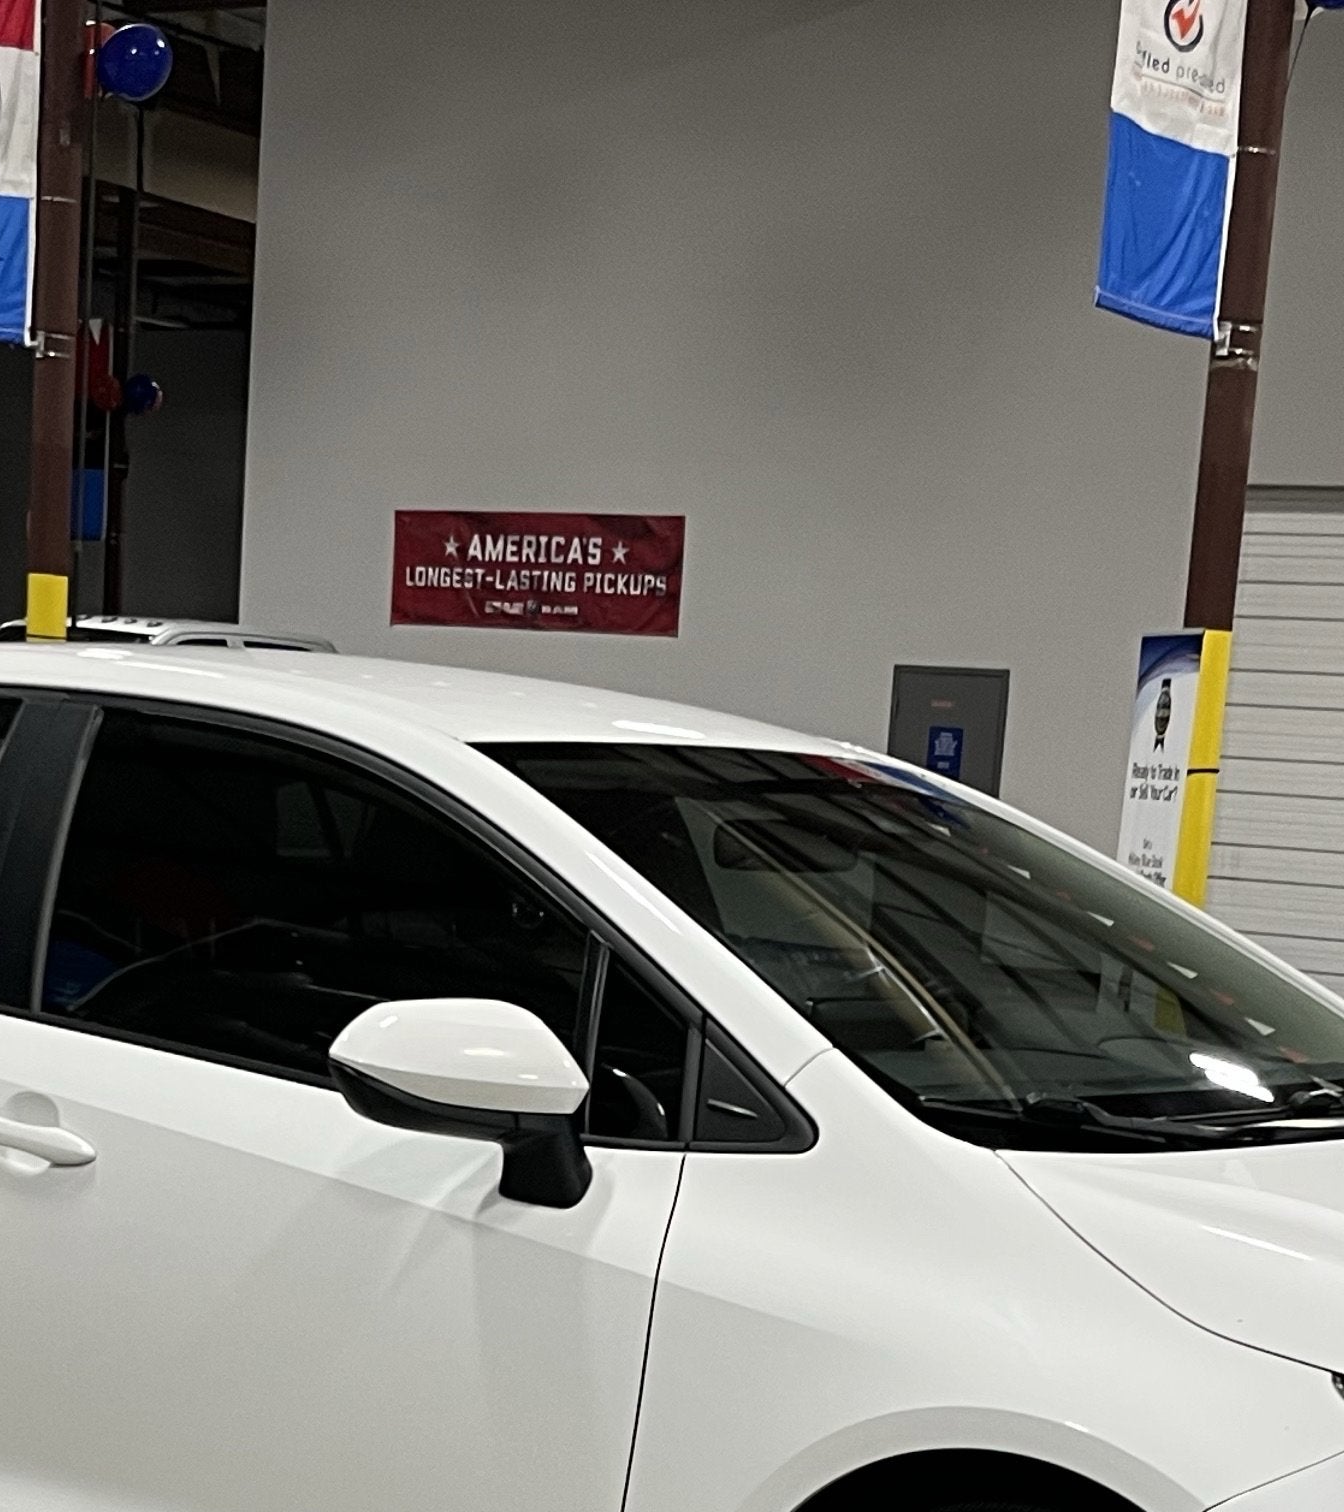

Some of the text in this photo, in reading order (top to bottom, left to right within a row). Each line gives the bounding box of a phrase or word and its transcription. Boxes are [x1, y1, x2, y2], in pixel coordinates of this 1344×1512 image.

[466, 534, 603, 566] AMERICA'S
[405, 566, 667, 597] LONGEST-LASTING PICKUPS
